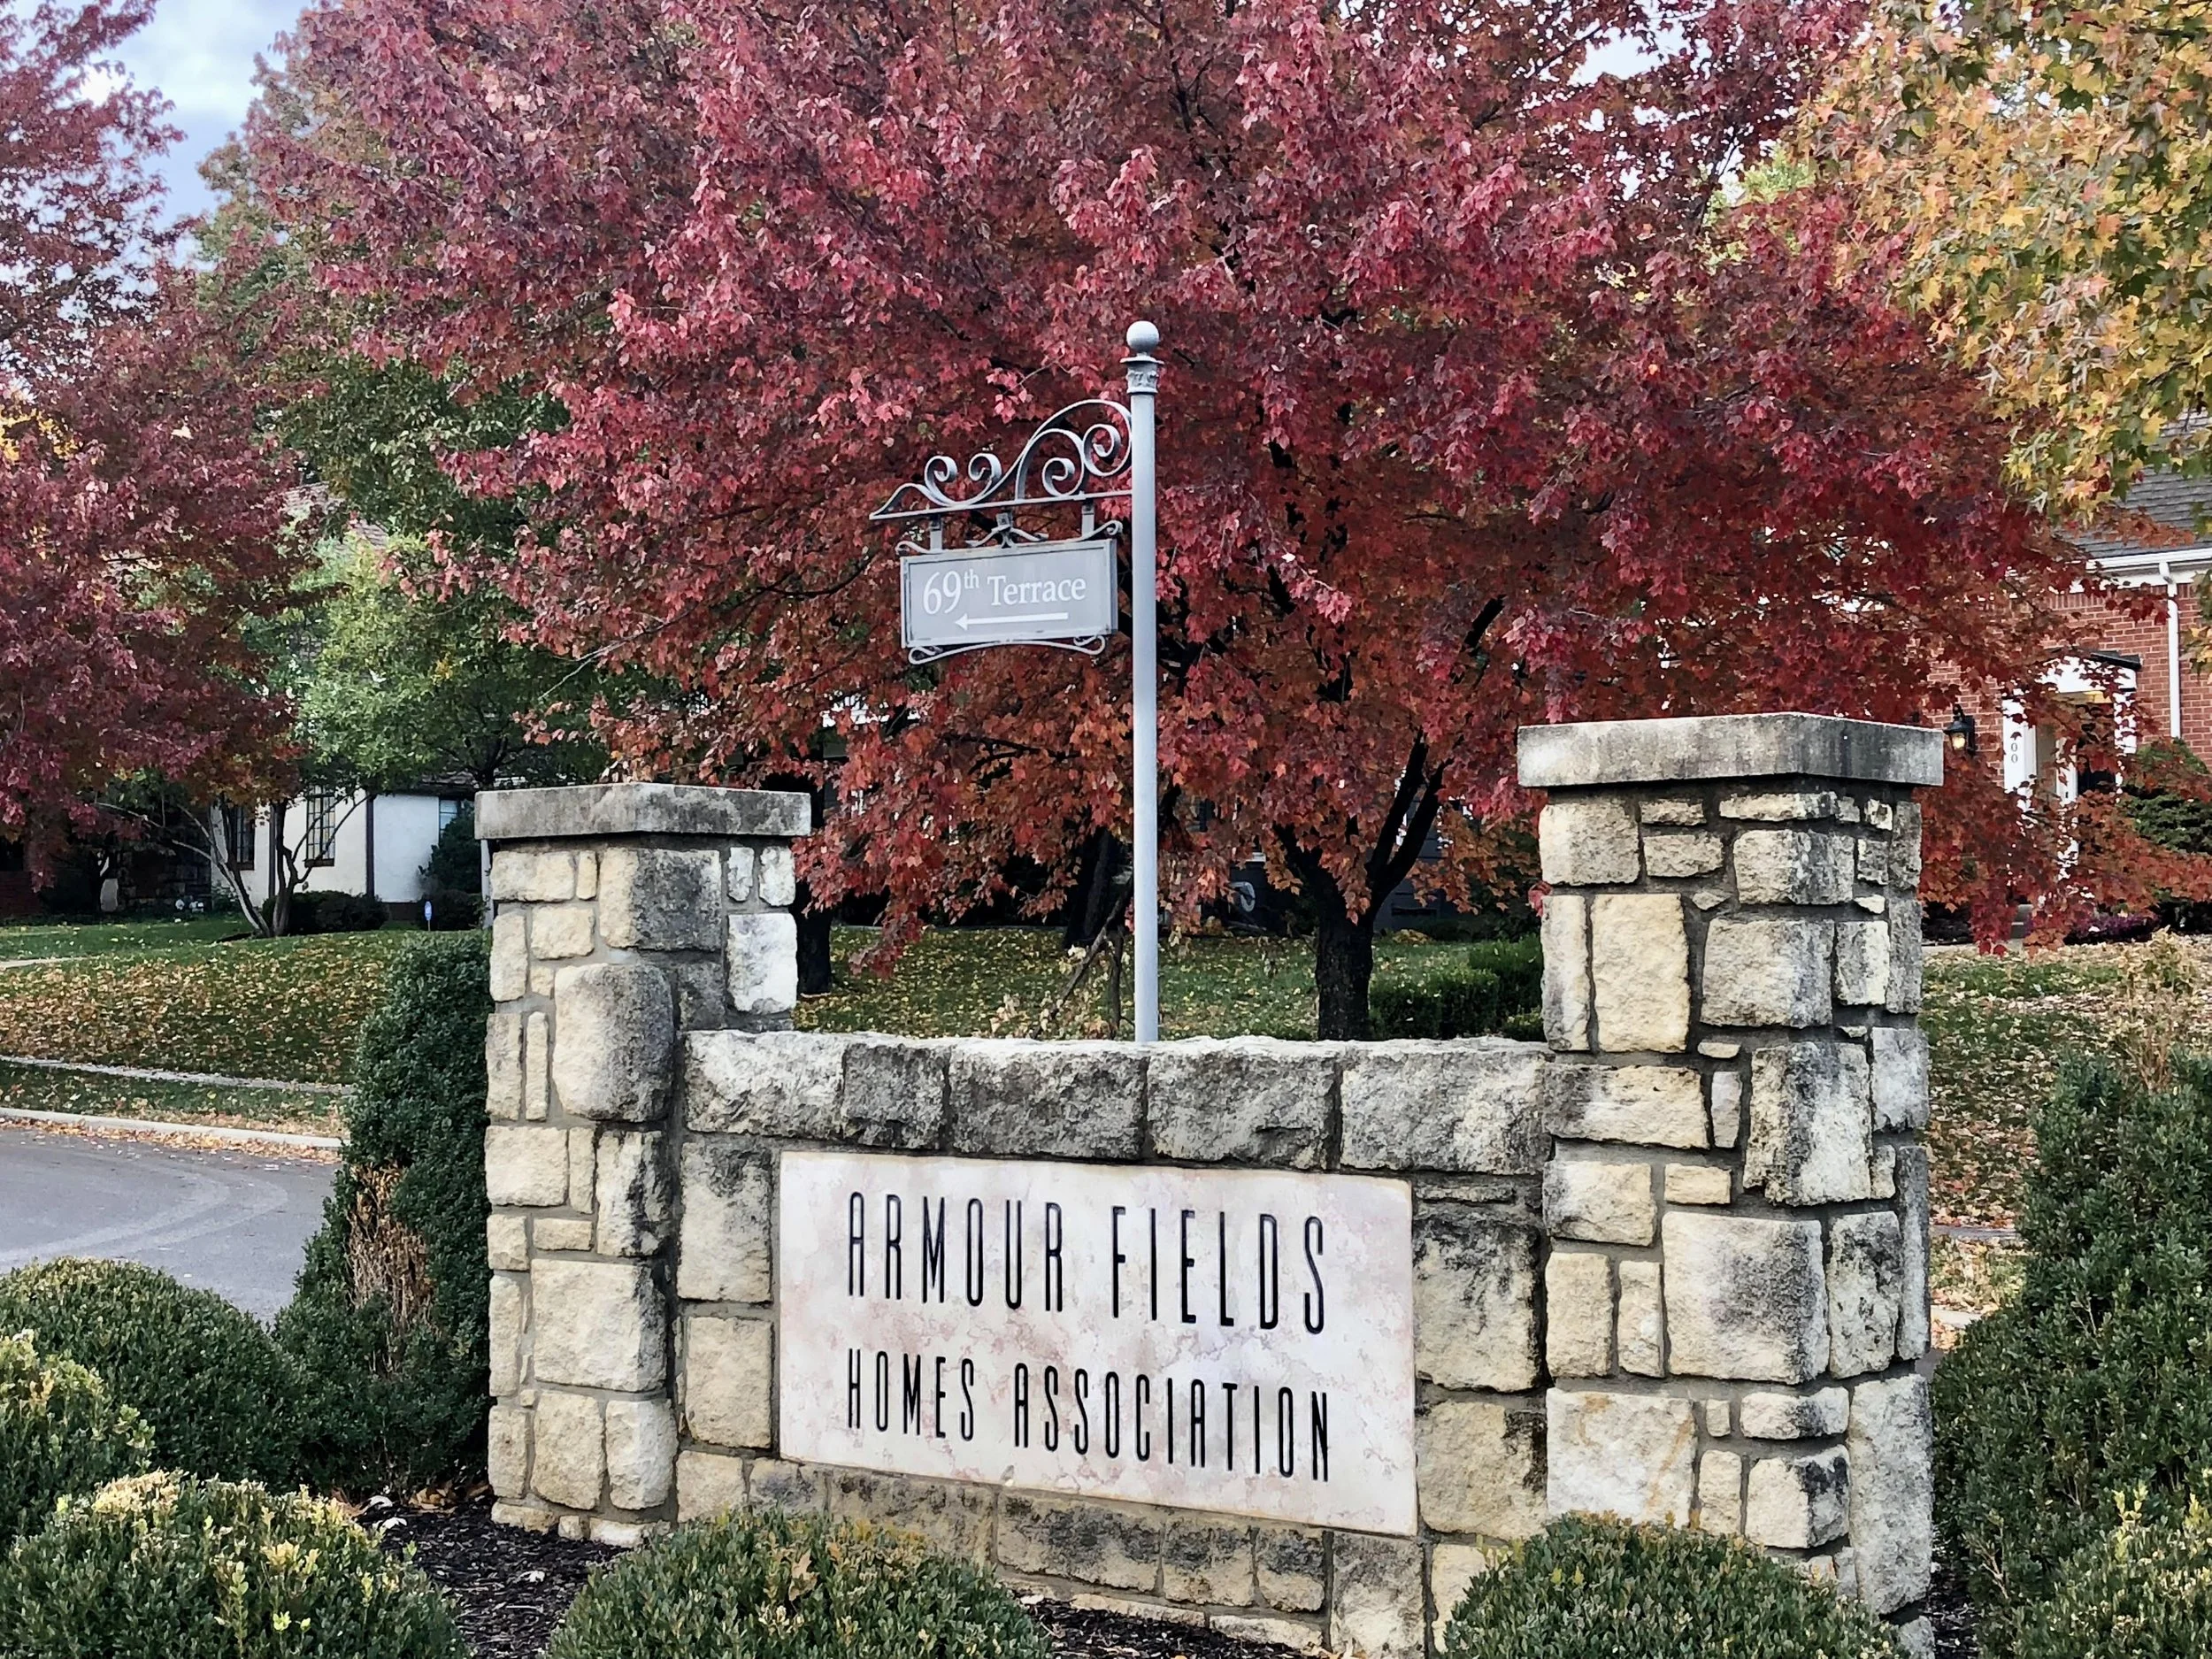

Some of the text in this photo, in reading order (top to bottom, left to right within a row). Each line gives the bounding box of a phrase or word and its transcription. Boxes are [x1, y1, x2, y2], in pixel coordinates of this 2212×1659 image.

[923, 569, 1087, 615] 69th Terrace
[848, 1191, 1325, 1334] ARMOUR FIELDS
[848, 1348, 1329, 1482] HOMES ASSOCIATION
